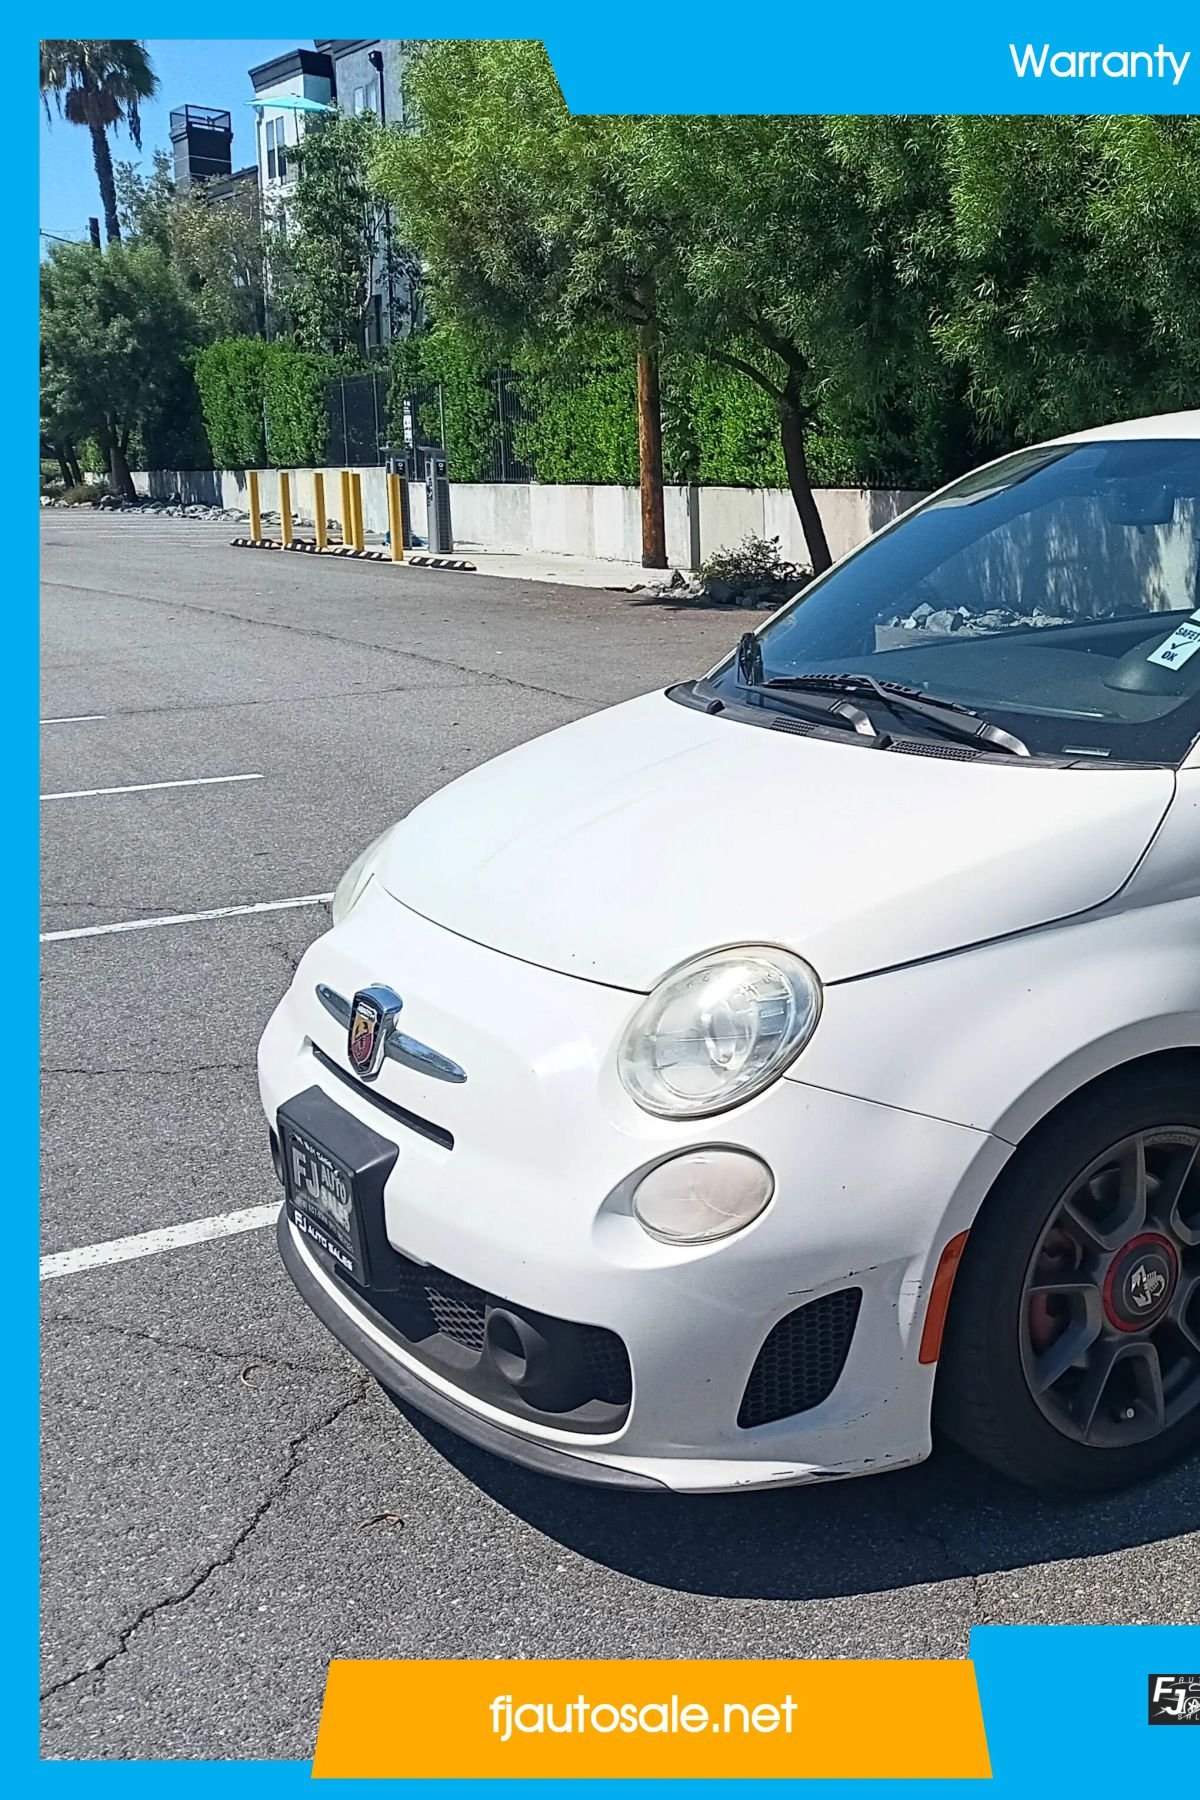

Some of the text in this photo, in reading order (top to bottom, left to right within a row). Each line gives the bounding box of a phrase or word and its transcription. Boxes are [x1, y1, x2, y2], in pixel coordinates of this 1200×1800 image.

[1161, 650, 1179, 662] OK
[292, 1146, 320, 1198] FJ
[321, 1164, 347, 1205] AUTO
[294, 1210, 307, 1232] FJ
[308, 1225, 328, 1248] AUTO
[328, 1242, 353, 1272] SALES
